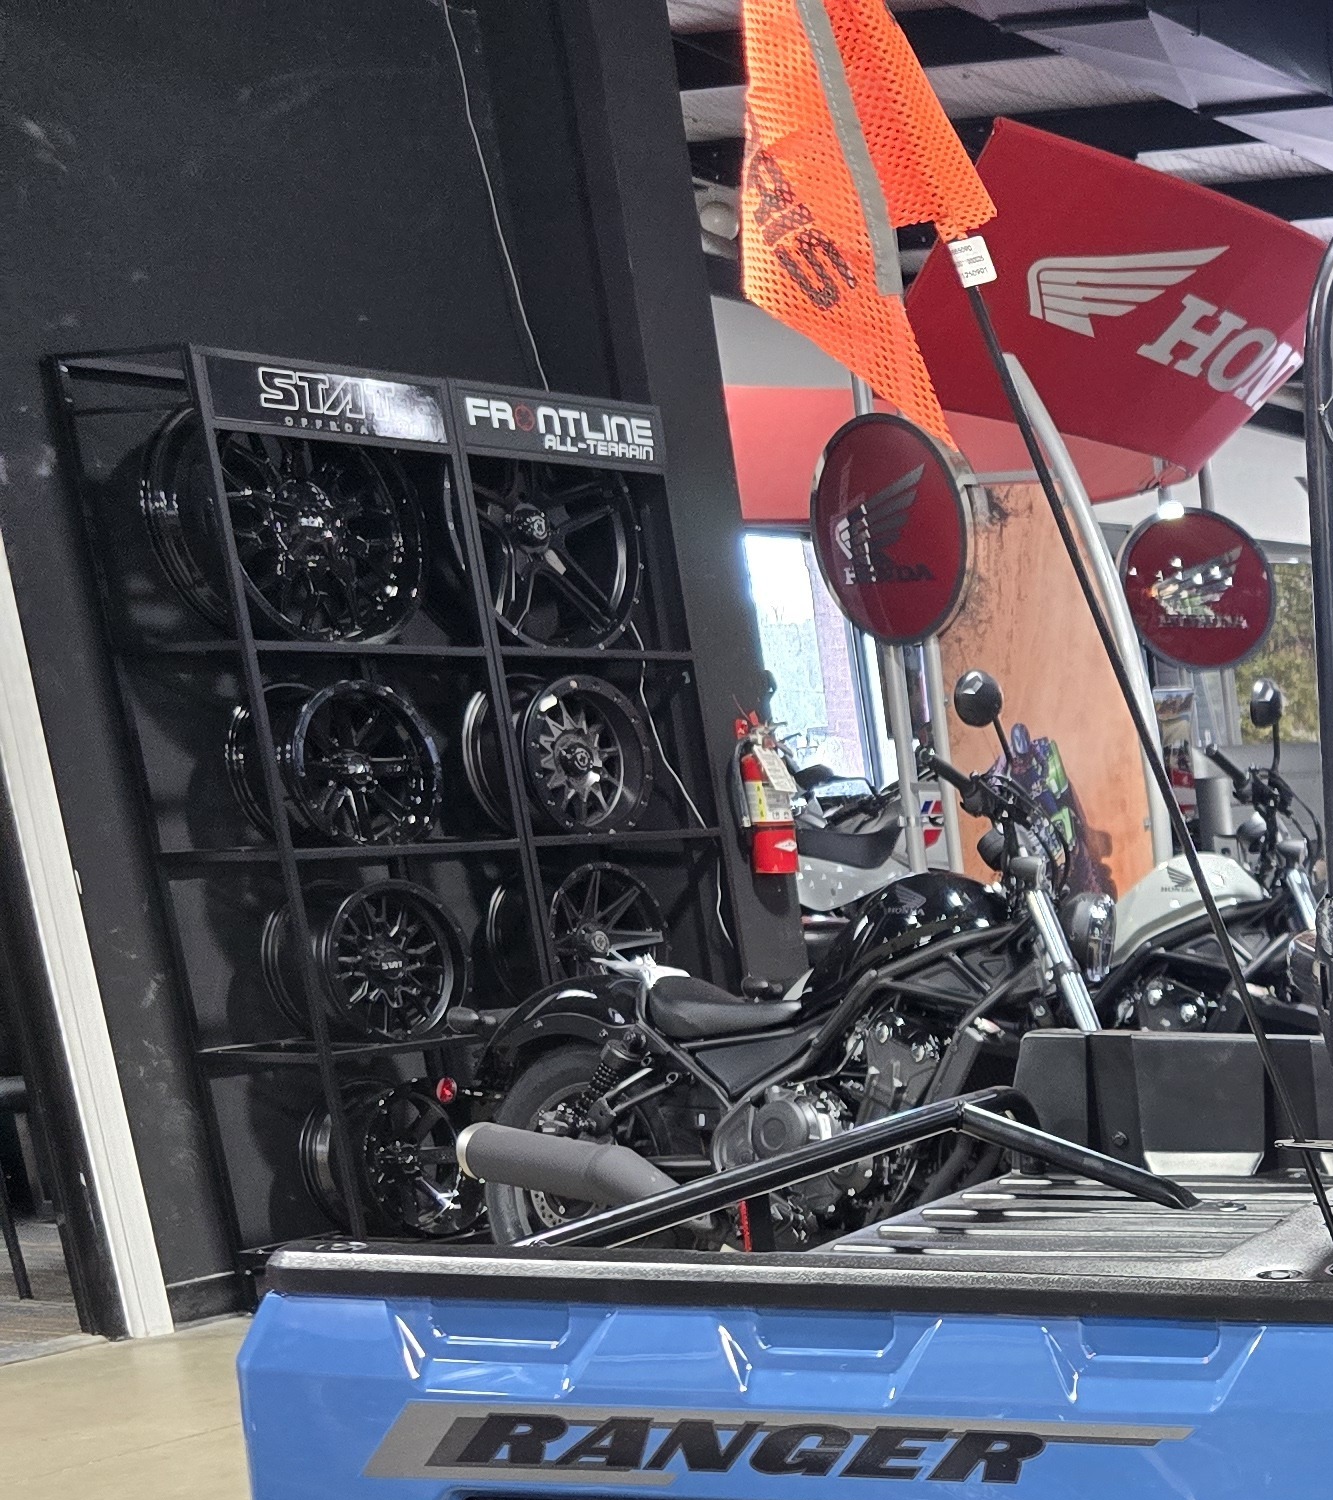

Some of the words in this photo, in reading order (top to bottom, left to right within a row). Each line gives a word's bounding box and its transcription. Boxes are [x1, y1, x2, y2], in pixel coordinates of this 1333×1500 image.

[465, 397, 654, 447] FRONTLINE
[544, 434, 654, 461] ALL-TERRAIN
[455, 1410, 1047, 1484] RANGER
